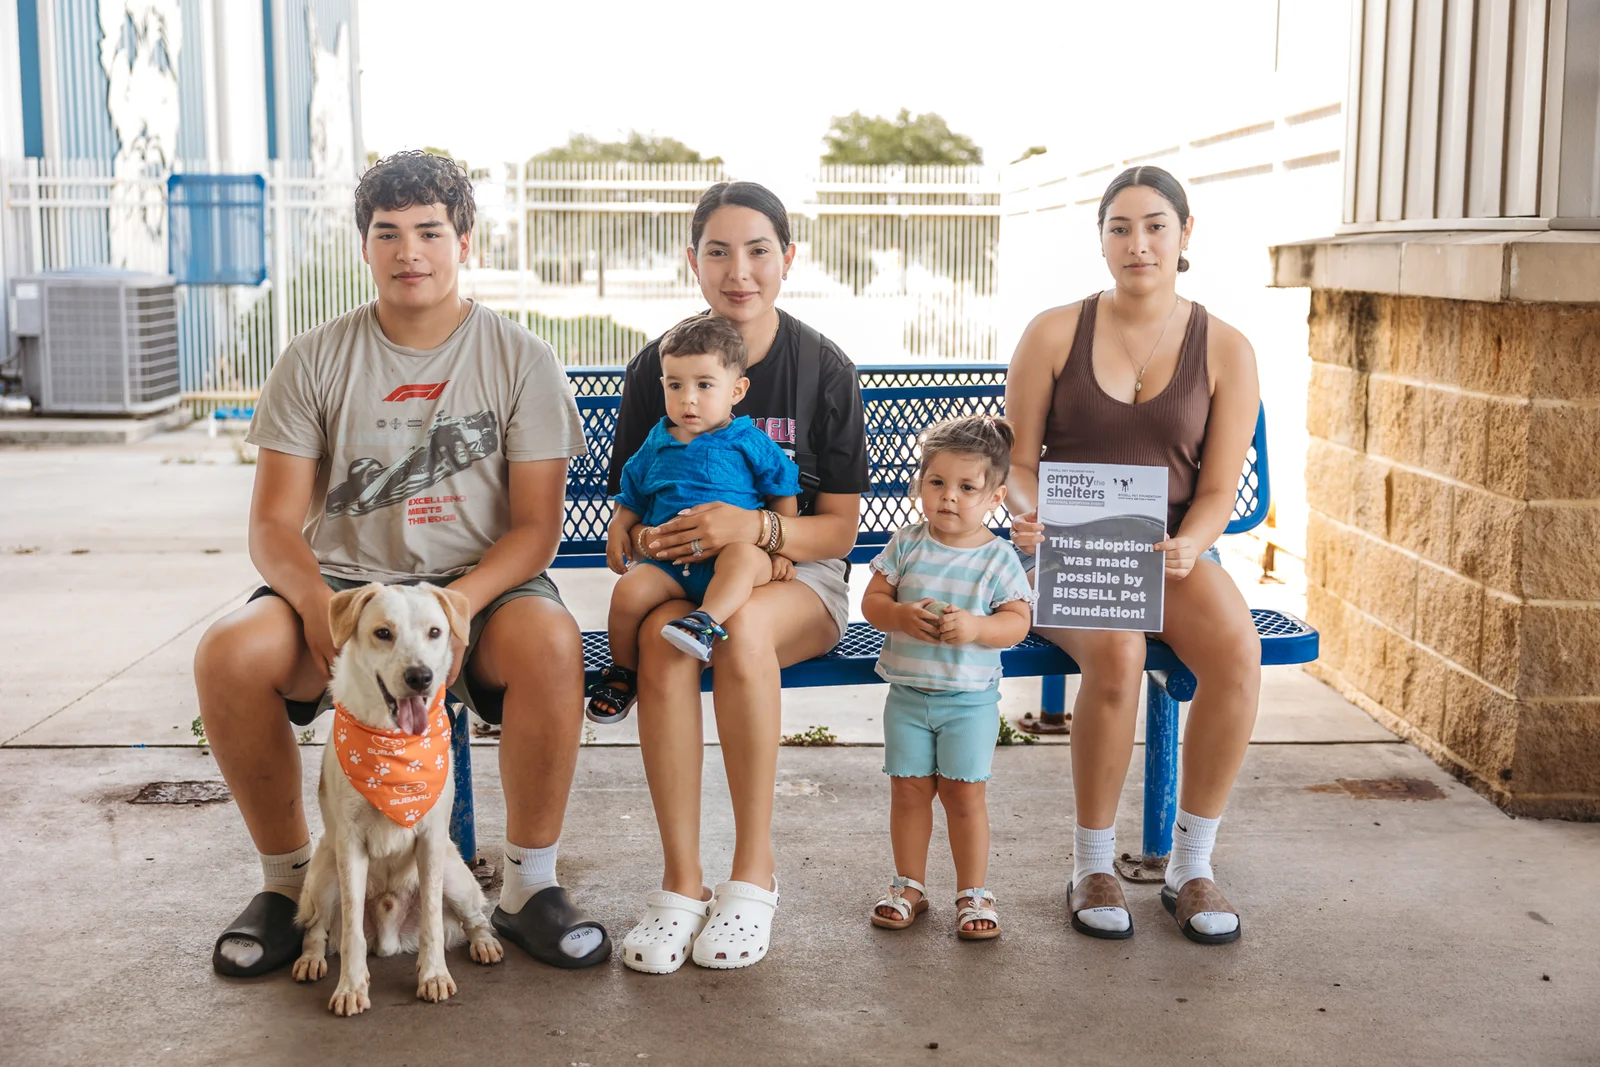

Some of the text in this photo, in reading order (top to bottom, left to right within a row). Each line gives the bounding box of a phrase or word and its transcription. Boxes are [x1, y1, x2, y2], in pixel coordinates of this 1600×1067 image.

[382, 380, 450, 402] F1
[1047, 474, 1094, 488] empty
[1047, 485, 1105, 499] shelters
[408, 506, 442, 516] MEETS
[408, 514, 456, 525] THE EDGE
[1050, 537, 1154, 553] This adoption
[1063, 556, 1139, 569] was made
[1057, 571, 1143, 587] possible by
[1053, 587, 1146, 602] BISSELL Pet
[1052, 604, 1145, 619] Foundation!
[367, 747, 406, 757] SUBARU
[390, 793, 431, 806] SUBARU
